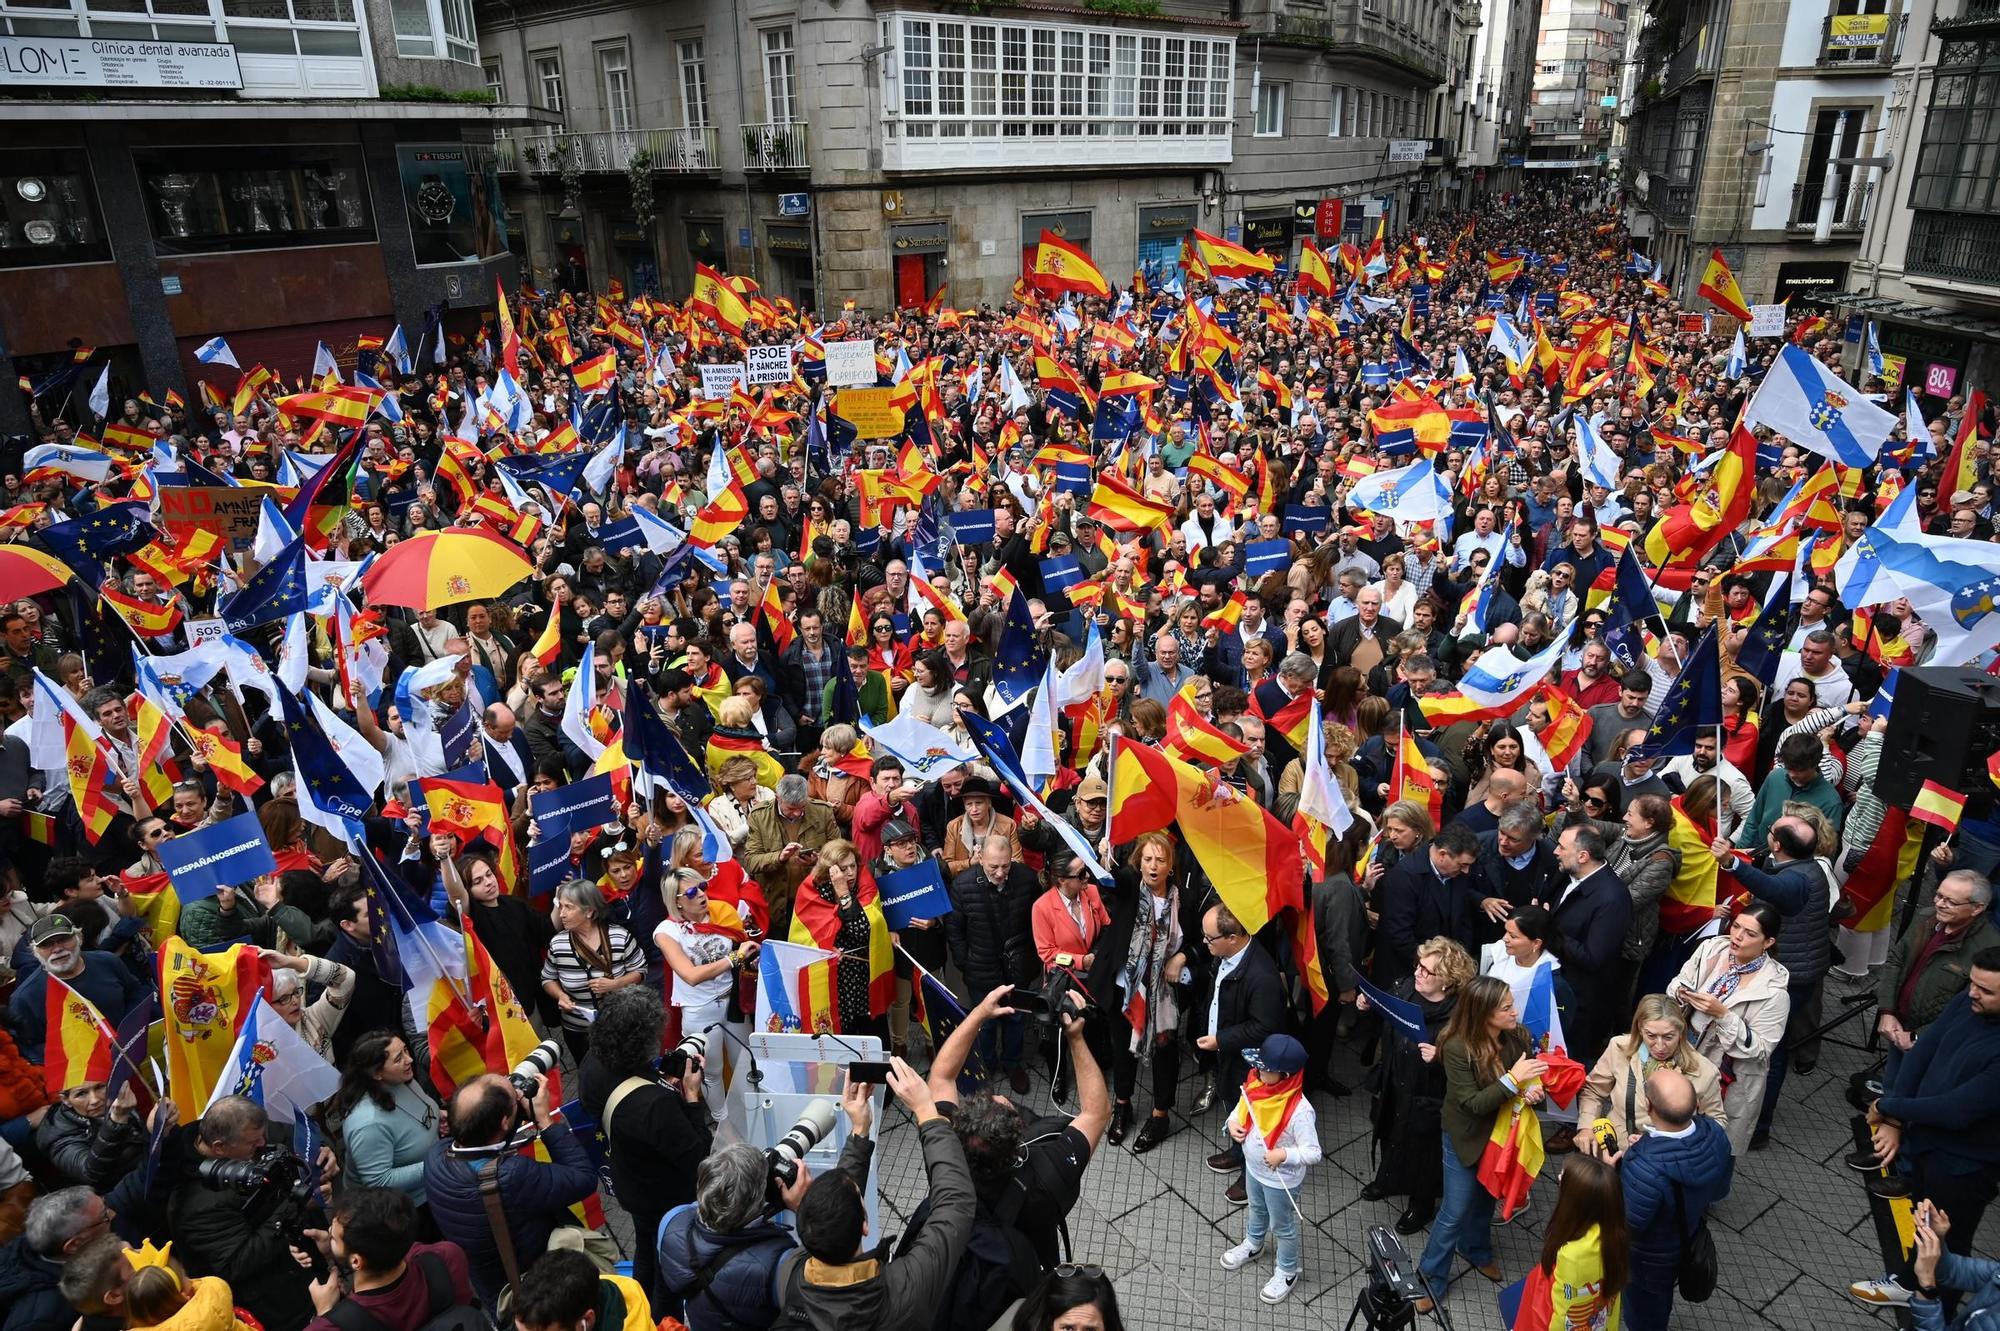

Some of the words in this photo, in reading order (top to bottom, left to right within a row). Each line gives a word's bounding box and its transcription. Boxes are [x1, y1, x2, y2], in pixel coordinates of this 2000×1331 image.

[139, 43, 174, 56] dental
[178, 46, 231, 58] avanzada
[3, 46, 86, 74] LOME
[432, 152, 462, 160] TISSOT
[908, 235, 948, 247] Santander
[750, 346, 787, 360] PSOE
[756, 360, 788, 370] SÁNCHEZ
[750, 374, 756, 382] A
[756, 371, 789, 382] PRISIÓN
[1882, 368, 1900, 379] LACK
[1928, 367, 1952, 391] 80%
[162, 489, 214, 516] NO
[196, 627, 222, 636] SOS
[1621, 653, 1635, 667] ppe
[1001, 689, 1015, 702] ppe
[338, 803, 363, 816] ppe
[537, 794, 610, 821] #ESPAÑANOSERINDE
[172, 838, 262, 877] #ESPAÑANOSERINDE
[533, 850, 570, 875] #ESPAÑANO
[880, 884, 935, 907] PAÑANOSERINDE
